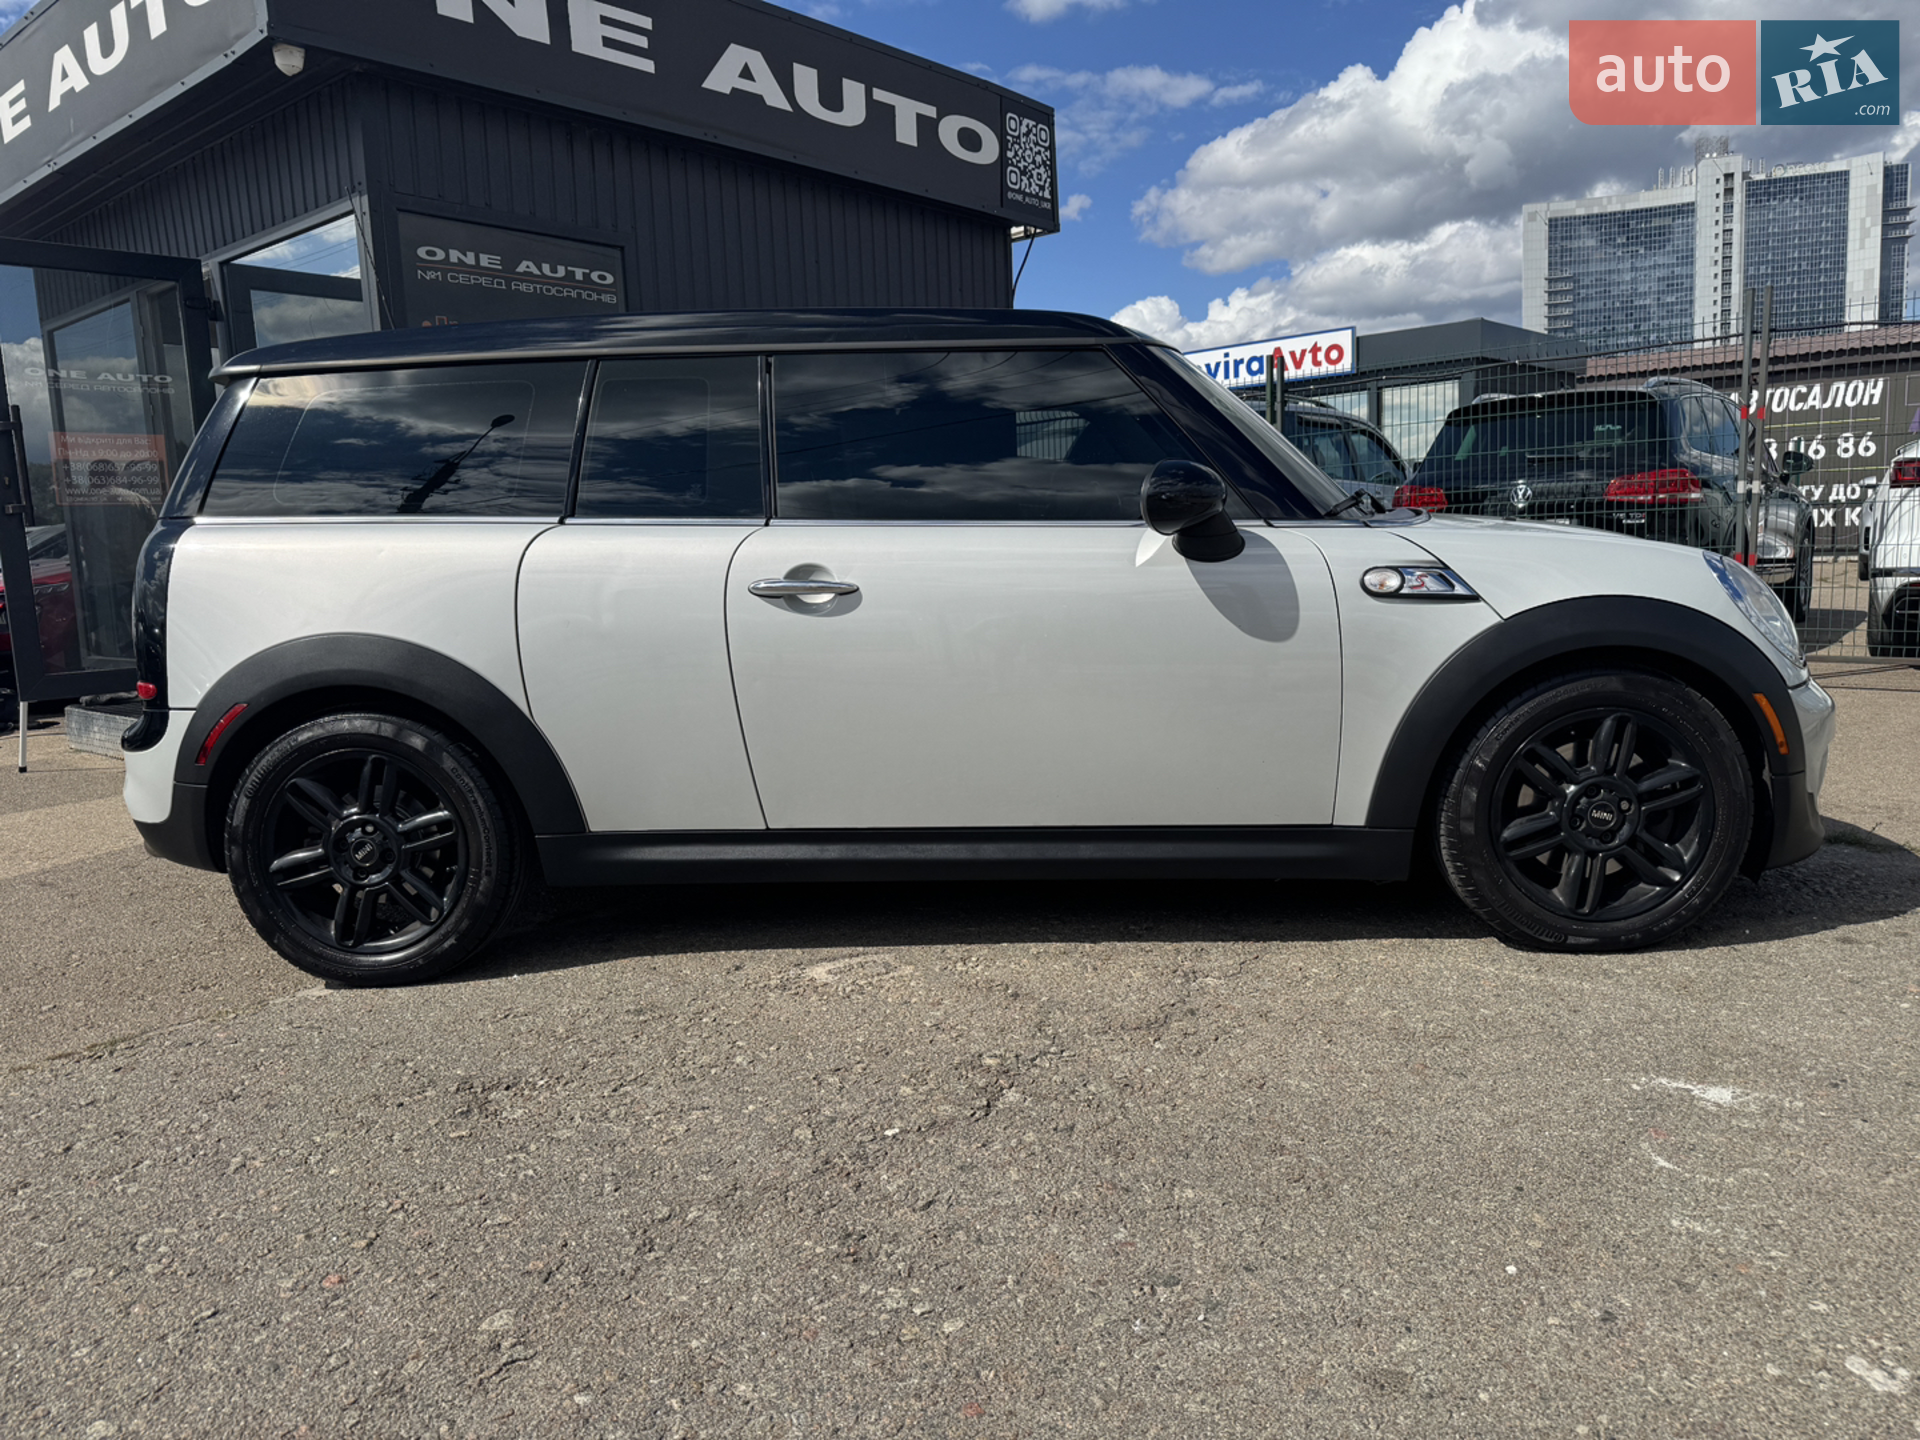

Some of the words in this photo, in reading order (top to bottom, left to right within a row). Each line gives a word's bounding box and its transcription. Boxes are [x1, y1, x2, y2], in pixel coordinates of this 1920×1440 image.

[48, 0, 211, 112] AUT
[701, 42, 1000, 165] AUTO
[416, 246, 503, 269] ONE
[514, 260, 615, 285] AUTO
[417, 269, 442, 281] №1
[447, 272, 507, 290] СЕРЕД
[511, 281, 617, 304] АВТОСАЛОНІВ
[24, 367, 87, 380] ONE
[97, 372, 173, 383] AUTO
[98, 449, 118, 458] 9:00
[119, 451, 132, 459] до
[134, 449, 159, 459] 20:00
[116, 437, 133, 446] для
[1836, 431, 1878, 460] 86
[354, 843, 373, 861] MINI
